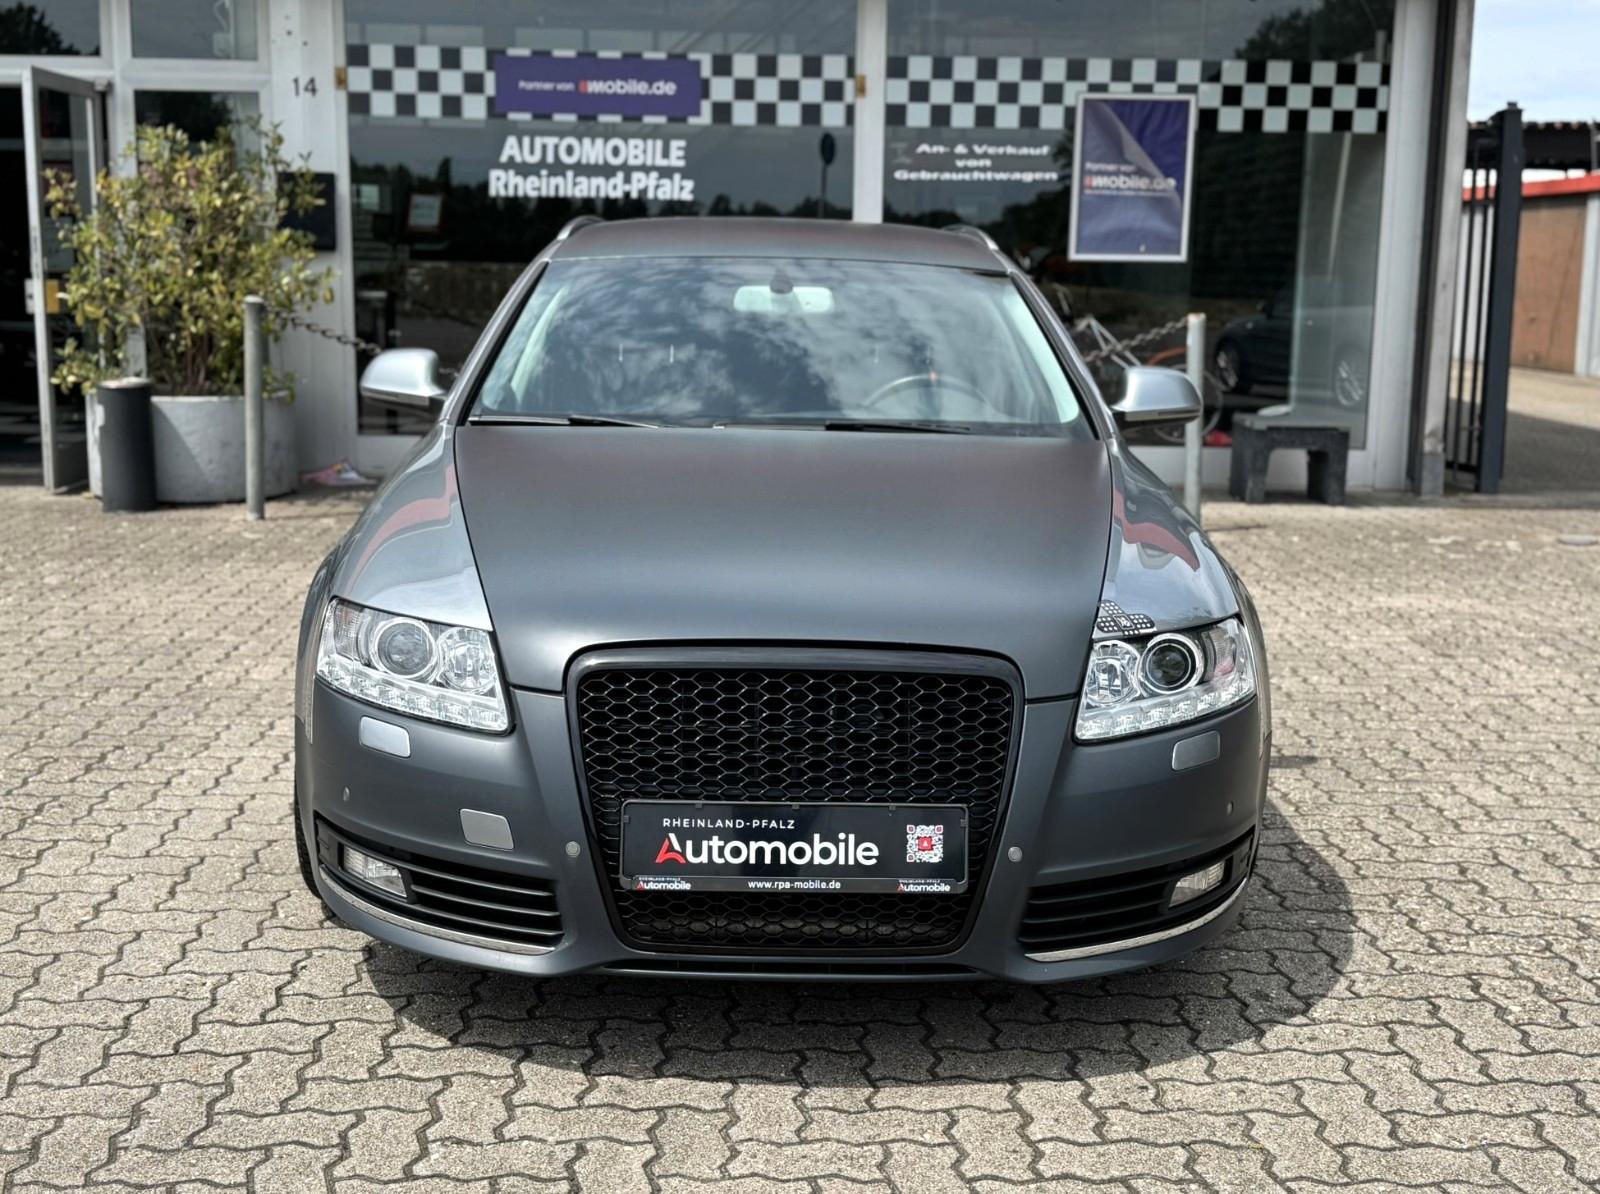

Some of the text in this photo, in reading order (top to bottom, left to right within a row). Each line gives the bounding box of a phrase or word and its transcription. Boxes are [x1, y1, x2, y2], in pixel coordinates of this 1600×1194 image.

[292, 76, 318, 98] 14
[518, 79, 678, 96] Partner von mobile.de
[500, 135, 687, 167] AUTOMOBILE
[972, 144, 1049, 156] Verkauf
[955, 158, 992, 168] von
[893, 169, 1058, 182] Gebrauchtwagen
[488, 168, 695, 201] Rheinland-Pfalz
[662, 817, 795, 829] RHEINLAND-PFALZ
[655, 832, 880, 866] Automobile
[635, 880, 692, 891] Automobile
[747, 880, 841, 890] www.rpa-mobile.de
[897, 882, 951, 893] Automobile
